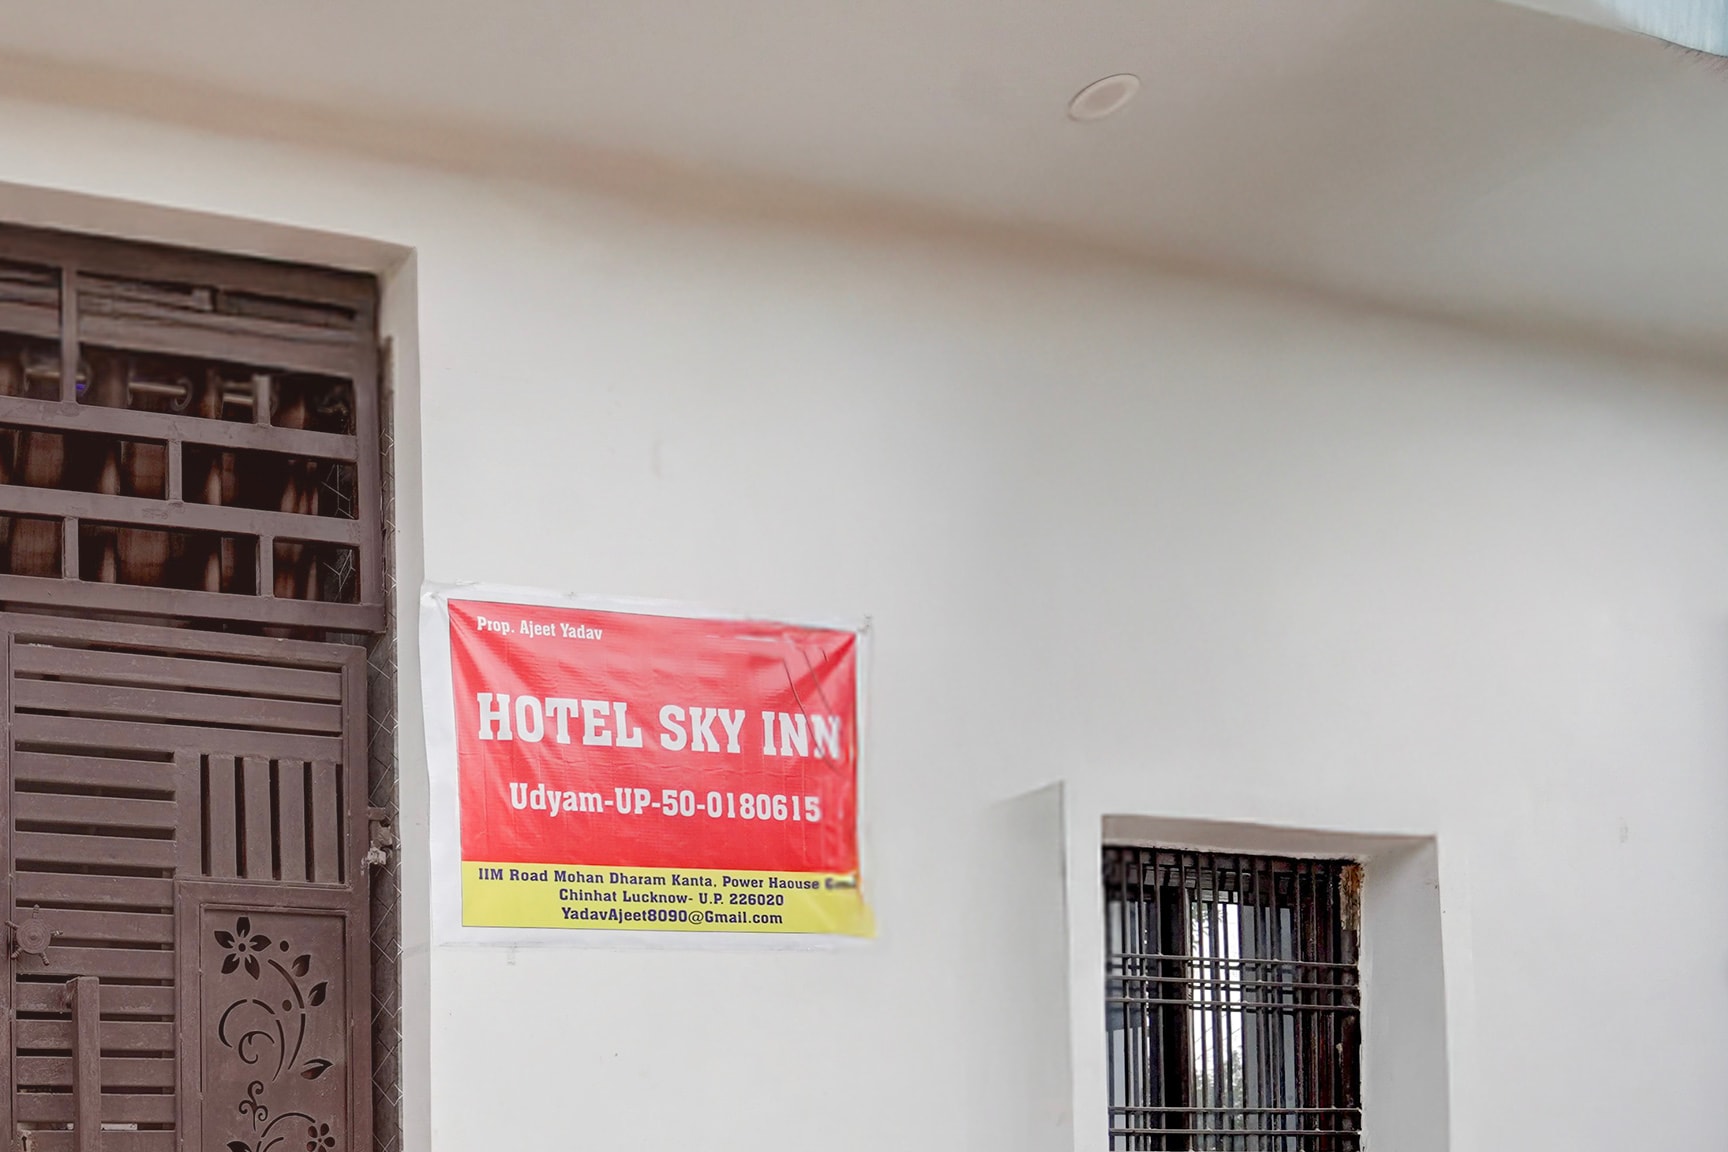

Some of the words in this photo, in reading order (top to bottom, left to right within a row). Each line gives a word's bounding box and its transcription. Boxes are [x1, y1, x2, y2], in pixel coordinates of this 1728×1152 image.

[477, 615, 515, 636] Prop.
[520, 619, 556, 638] Ajeet
[560, 622, 603, 640] Yadav
[476, 692, 643, 749] HOTEL
[658, 704, 746, 754] SKY
[761, 711, 841, 760] INN
[508, 782, 823, 823] Udyam-UP-50-0180615
[478, 867, 504, 881] IIM
[509, 868, 549, 882] Road
[554, 870, 604, 884] Mohan
[609, 872, 667, 886] Dharam
[722, 875, 764, 888] Power
[768, 877, 820, 890] Haouse
[559, 888, 617, 903] Chinhat
[622, 890, 694, 904] Lucknow-
[698, 892, 724, 905] U.P.
[729, 893, 785, 906] 226020
[561, 906, 784, 925] YadavAjeet8090@Gmail.com
